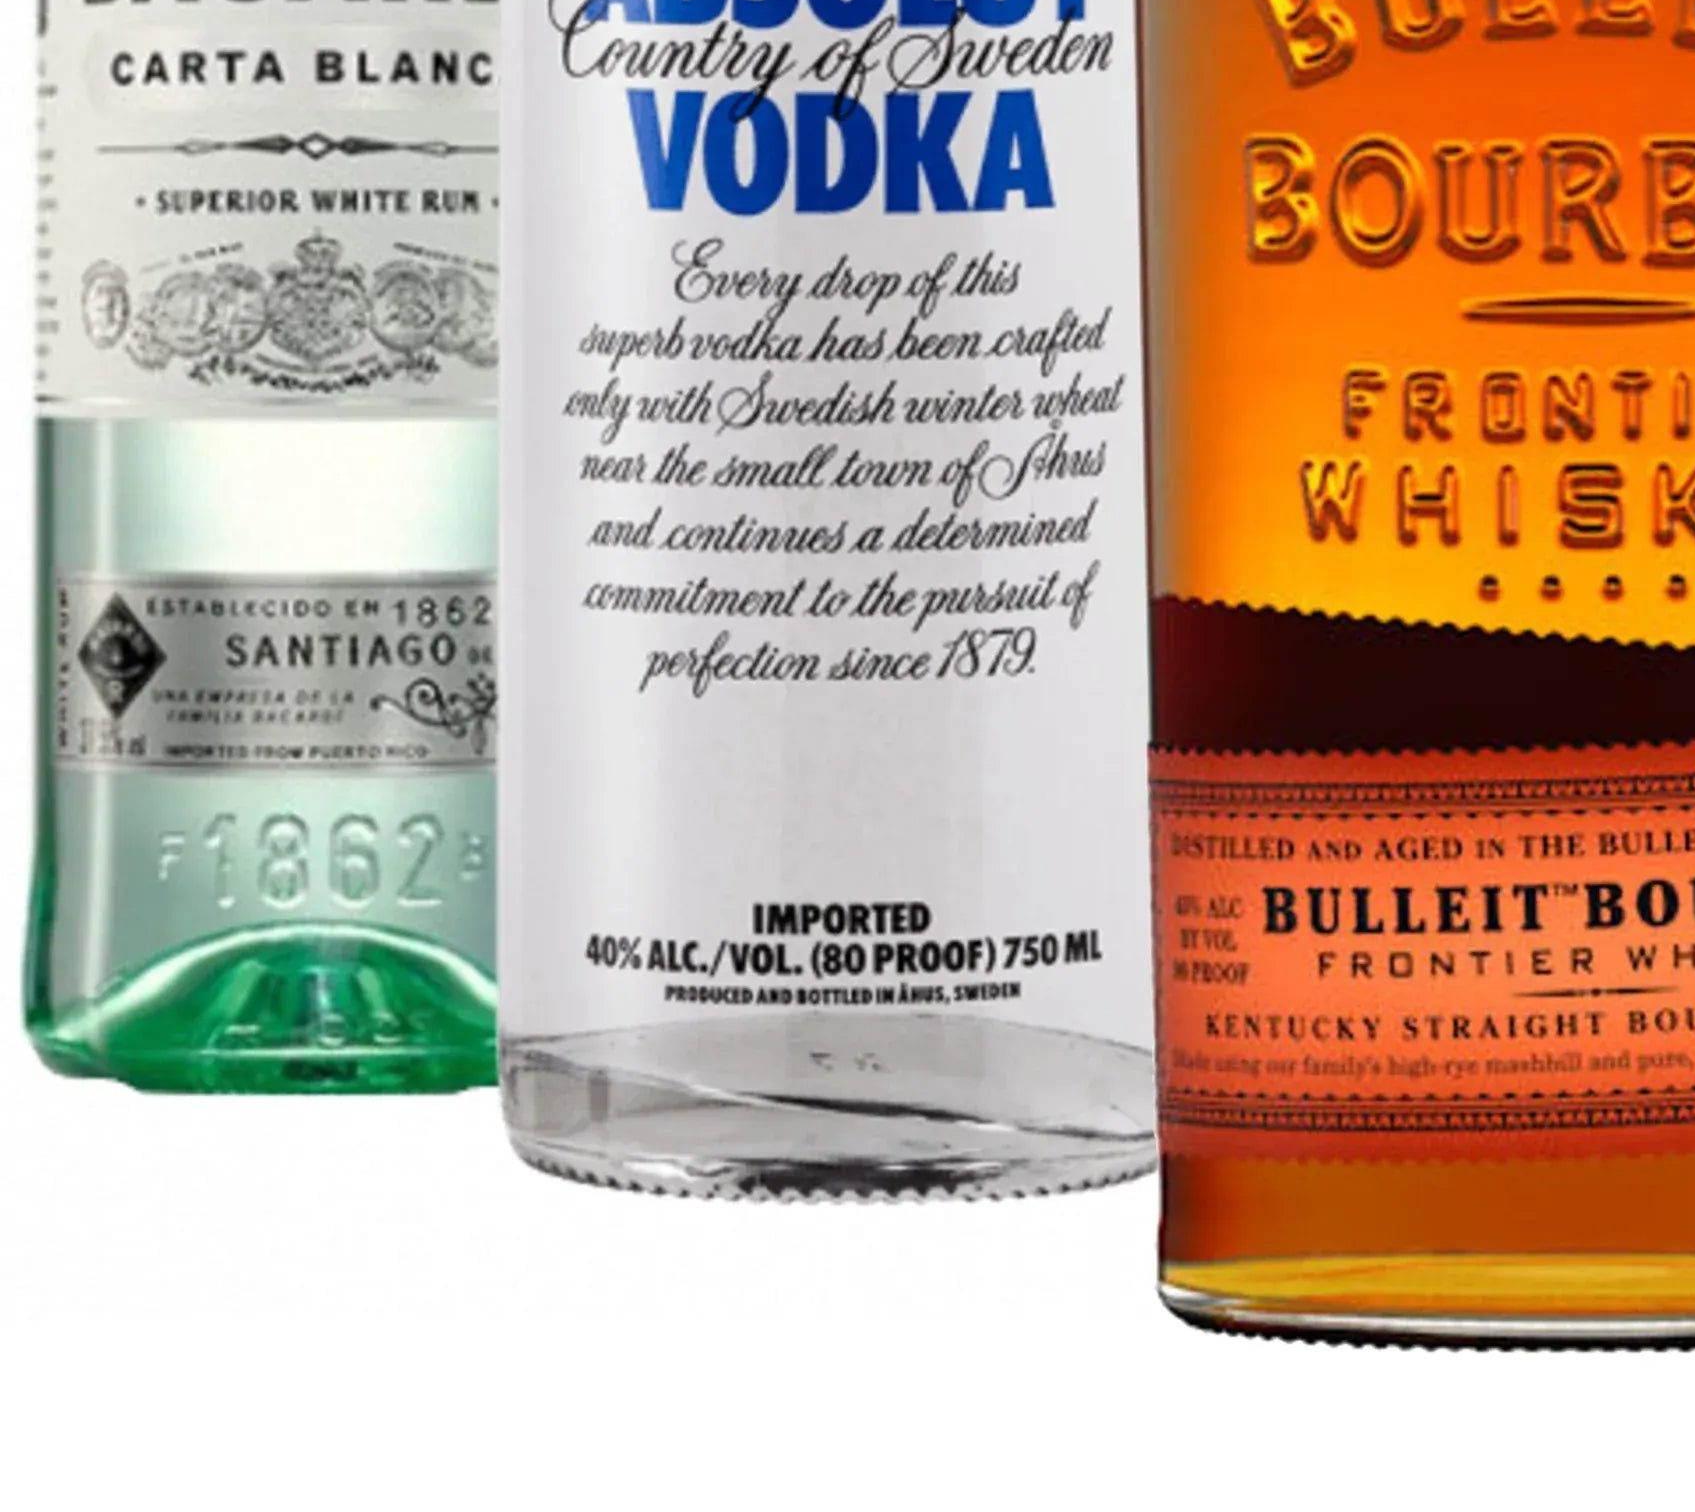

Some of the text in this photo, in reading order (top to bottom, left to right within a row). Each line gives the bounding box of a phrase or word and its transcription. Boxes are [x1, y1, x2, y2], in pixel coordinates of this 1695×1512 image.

[111, 50, 285, 86] CARTA
[800, 14, 897, 123] of
[886, 5, 1116, 99] Sweden
[626, 88, 1056, 217] VODKA
[157, 189, 480, 214] SUPERIOR WHITE RUM
[672, 238, 1022, 321] Every drop of this
[578, 306, 1112, 377] superb vodka has been crafted
[562, 369, 1126, 446] only with Swedish winter wheat
[580, 418, 1107, 509] near the small town of Åhus
[586, 497, 1099, 554] and continues a determined
[146, 595, 492, 628] ESTABLECIDO EN 1862
[582, 558, 1103, 633] commitment to the pursuit of
[225, 633, 457, 669] SANTIAGO
[638, 625, 1038, 698] perfection since 1879.
[164, 745, 250, 760] IMPORTED
[309, 745, 376, 760] PUERTO
[203, 812, 444, 912] 1862
[1170, 835, 1296, 861] DISTILLED
[1307, 839, 1362, 862] AND
[1375, 835, 1463, 862] AGED
[1475, 838, 1506, 860] IN
[1519, 834, 1587, 859] THE
[752, 901, 932, 936] IMPORTED
[585, 928, 1104, 980] 40% ALC./VOL. (80 PROOF) 750 ML
[1317, 947, 1595, 980] FRONTIER
[664, 984, 754, 1005] PRODUCED
[755, 985, 794, 1005] AND
[796, 986, 874, 1005] BOTTLED
[875, 986, 896, 1005] IN
[953, 981, 1022, 1002] SWEDEN
[1205, 1013, 1382, 1042] KENTUCKY
[1402, 1011, 1607, 1040] STRAIGHT
